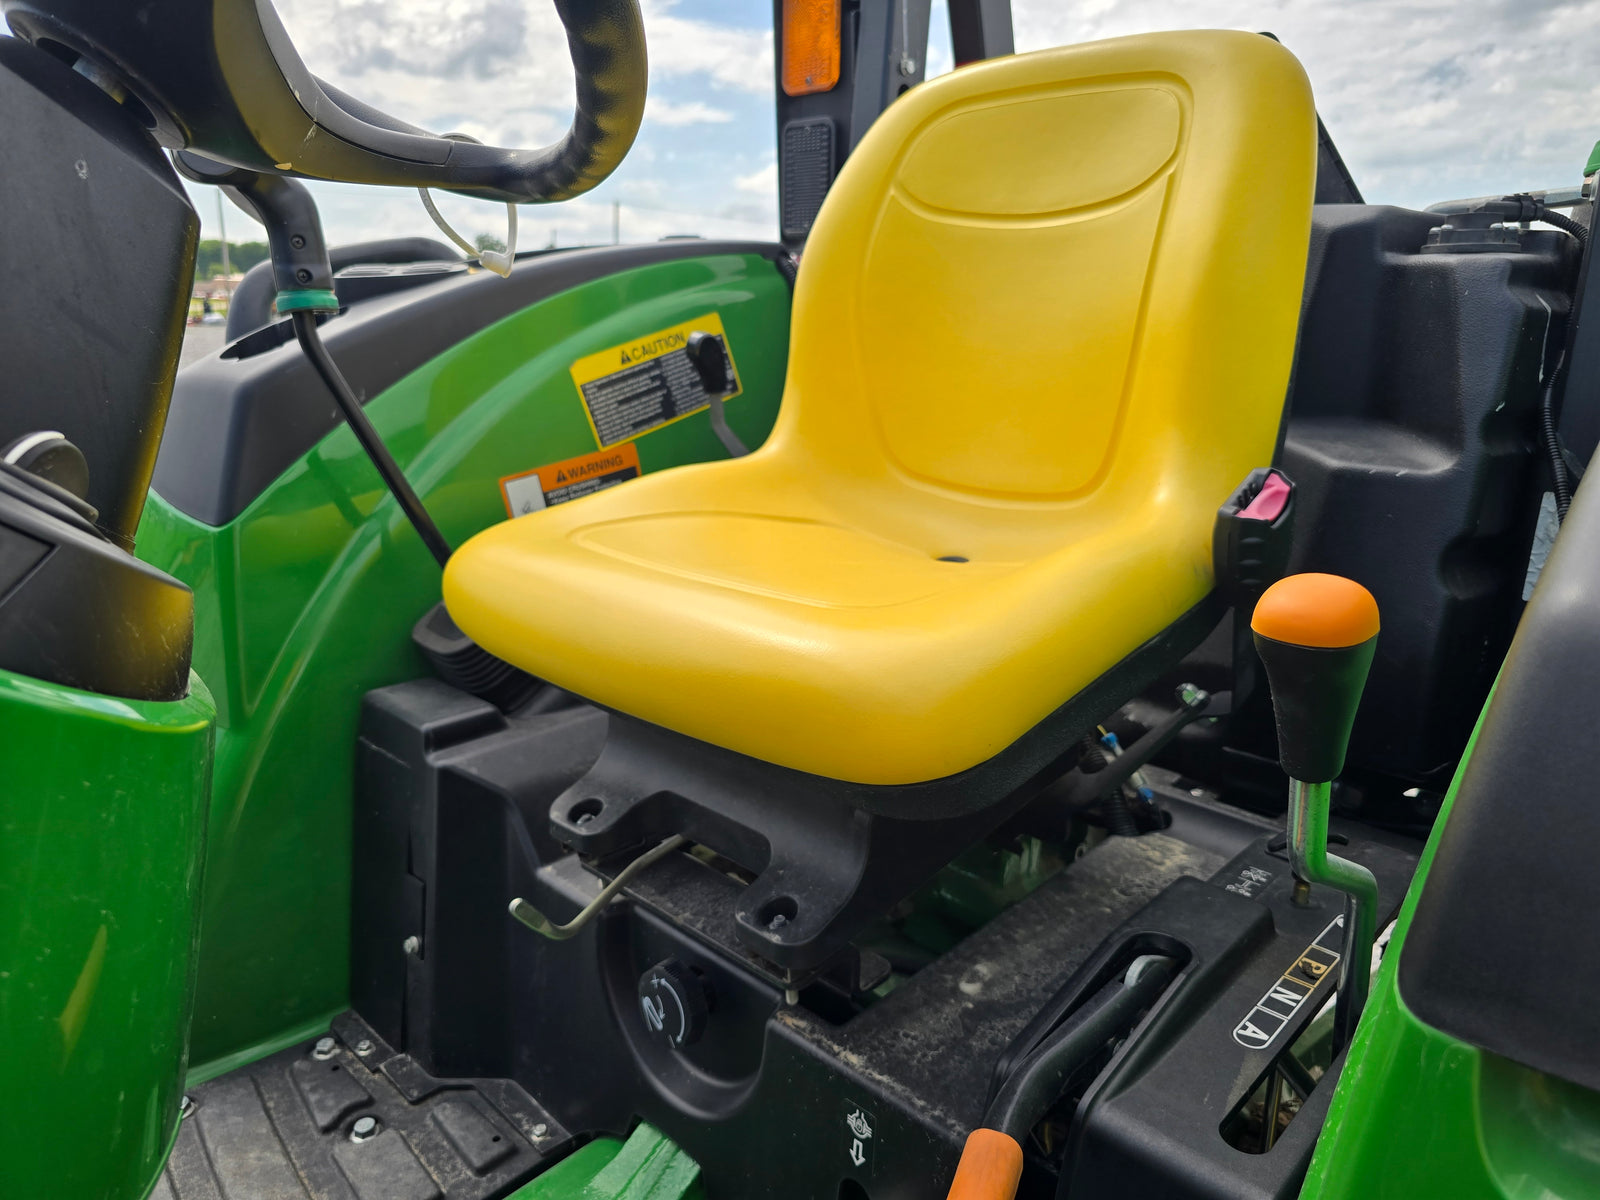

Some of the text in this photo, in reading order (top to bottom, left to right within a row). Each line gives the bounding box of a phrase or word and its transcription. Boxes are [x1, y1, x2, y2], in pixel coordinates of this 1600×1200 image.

[631, 331, 686, 361] CAUTION
[567, 455, 624, 479] WARNING
[1270, 986, 1303, 1007] N
[1237, 1021, 1270, 1041] A
